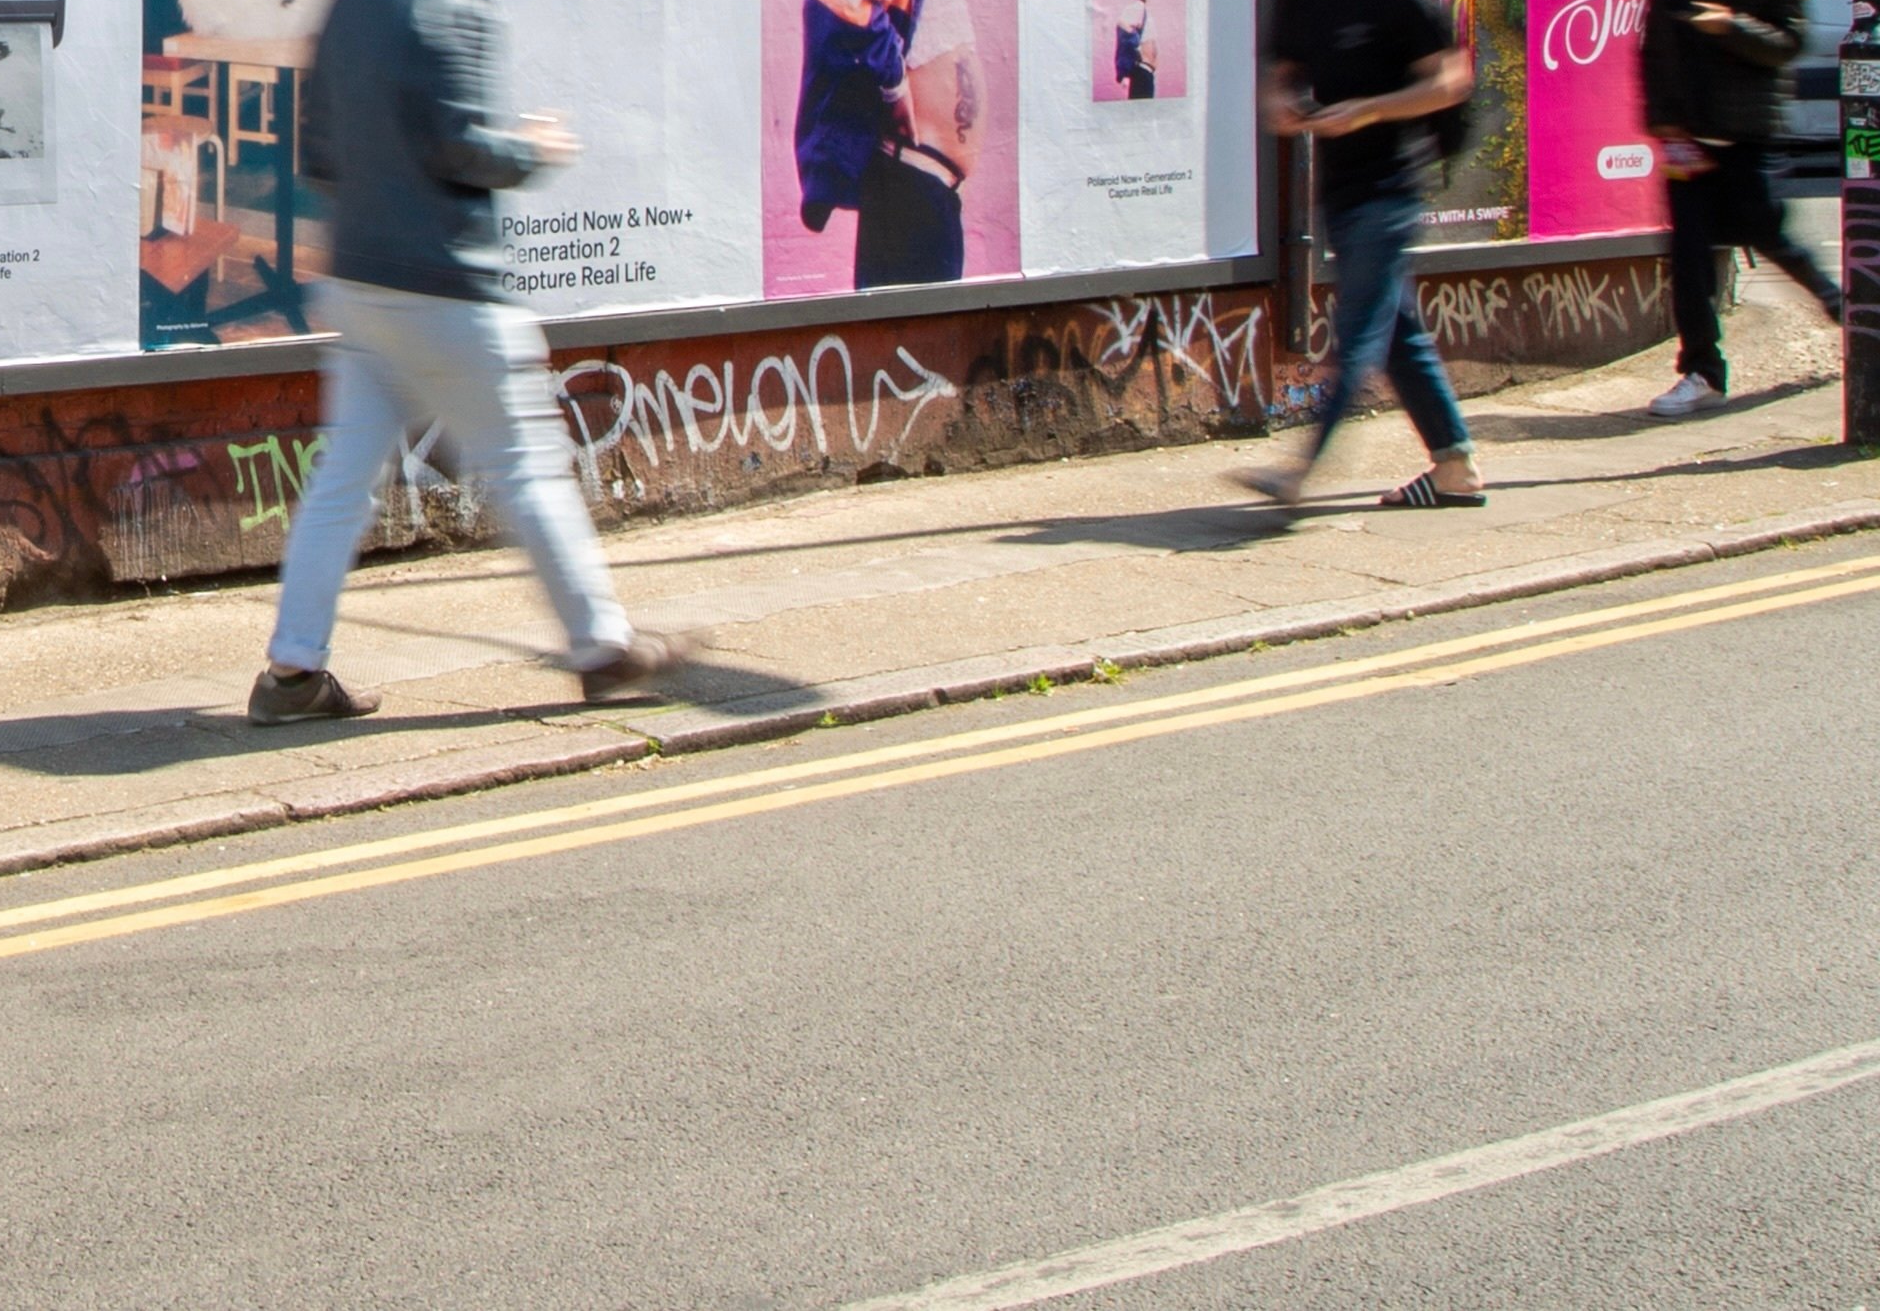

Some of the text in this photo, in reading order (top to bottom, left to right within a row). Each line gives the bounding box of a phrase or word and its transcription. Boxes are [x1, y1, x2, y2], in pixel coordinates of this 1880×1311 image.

[1614, 150, 1644, 169] tinder
[1087, 176, 1119, 187] Polaroid
[1144, 170, 1186, 183] Generation
[1187, 169, 1193, 180] 2
[1108, 184, 1174, 199] Capture Real Life
[501, 205, 694, 238] Polaroid Now & Now+
[1438, 209, 1466, 223] WITH
[1466, 209, 1475, 221] A
[32, 249, 40, 262] 2
[503, 236, 620, 265] Generation 2
[502, 261, 657, 295] Capture Real Life
